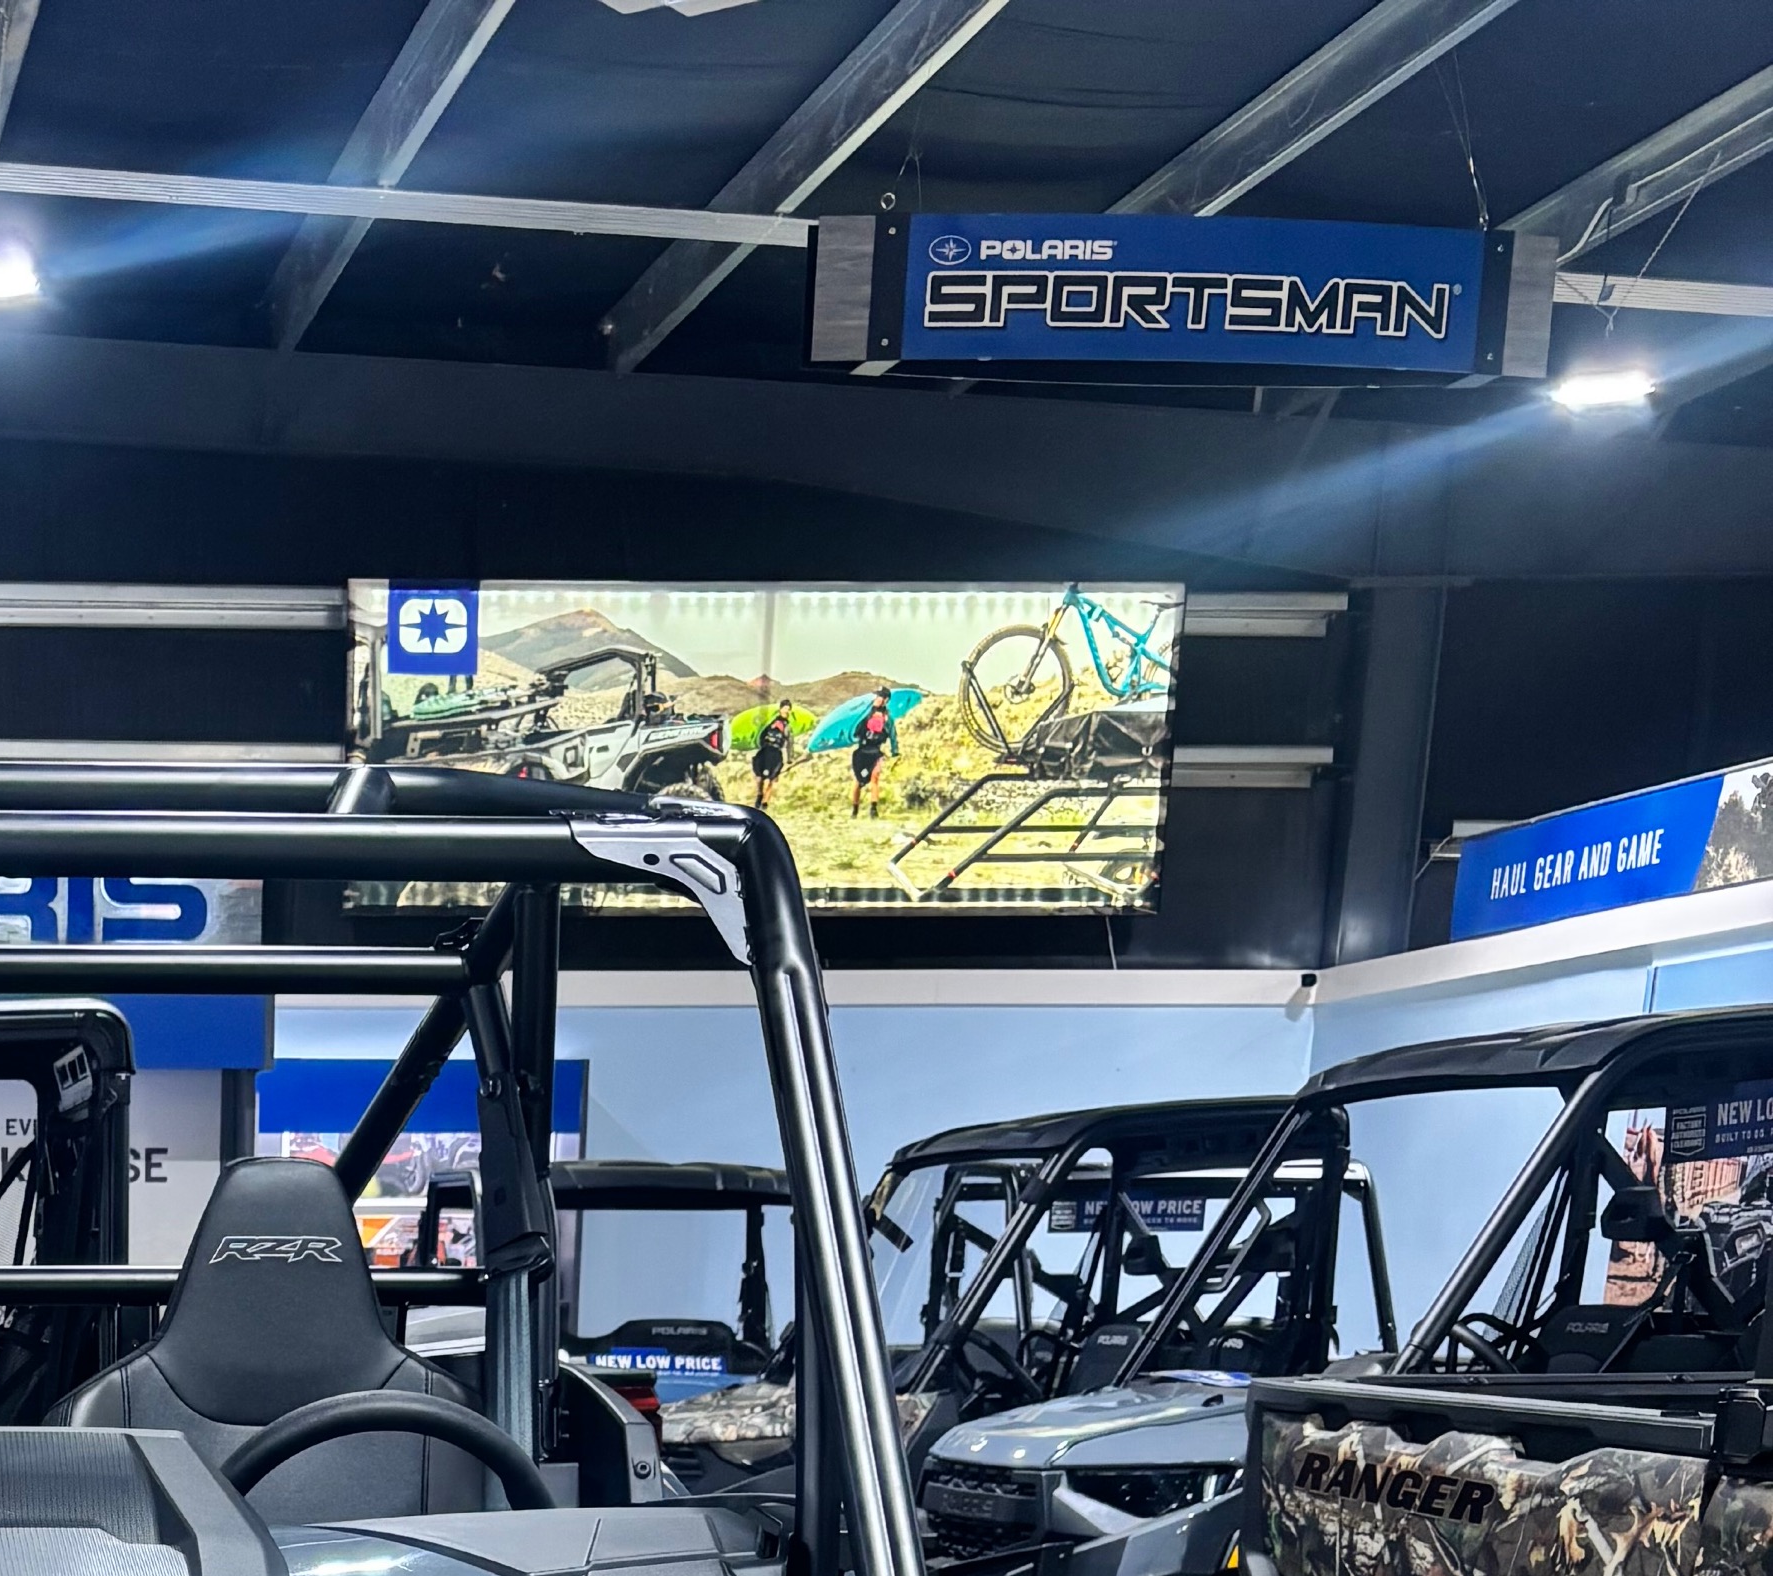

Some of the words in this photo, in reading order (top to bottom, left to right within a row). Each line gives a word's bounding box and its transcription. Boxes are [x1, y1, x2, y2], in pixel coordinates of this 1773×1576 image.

[979, 239, 1114, 261] POLARIS
[923, 270, 1449, 339] SPORTSMAN
[1490, 860, 1528, 901] HAUL
[1533, 850, 1575, 891] GEAR
[1577, 841, 1612, 881] AND
[1616, 828, 1665, 873] GAME
[1717, 1099, 1753, 1127] NEW
[1157, 1199, 1203, 1216] PRICE
[208, 1235, 343, 1265] RZR
[594, 1354, 632, 1369] NEW
[635, 1354, 671, 1370] LOW
[674, 1356, 723, 1372] PRICE
[1294, 1451, 1497, 1525] RANGER
